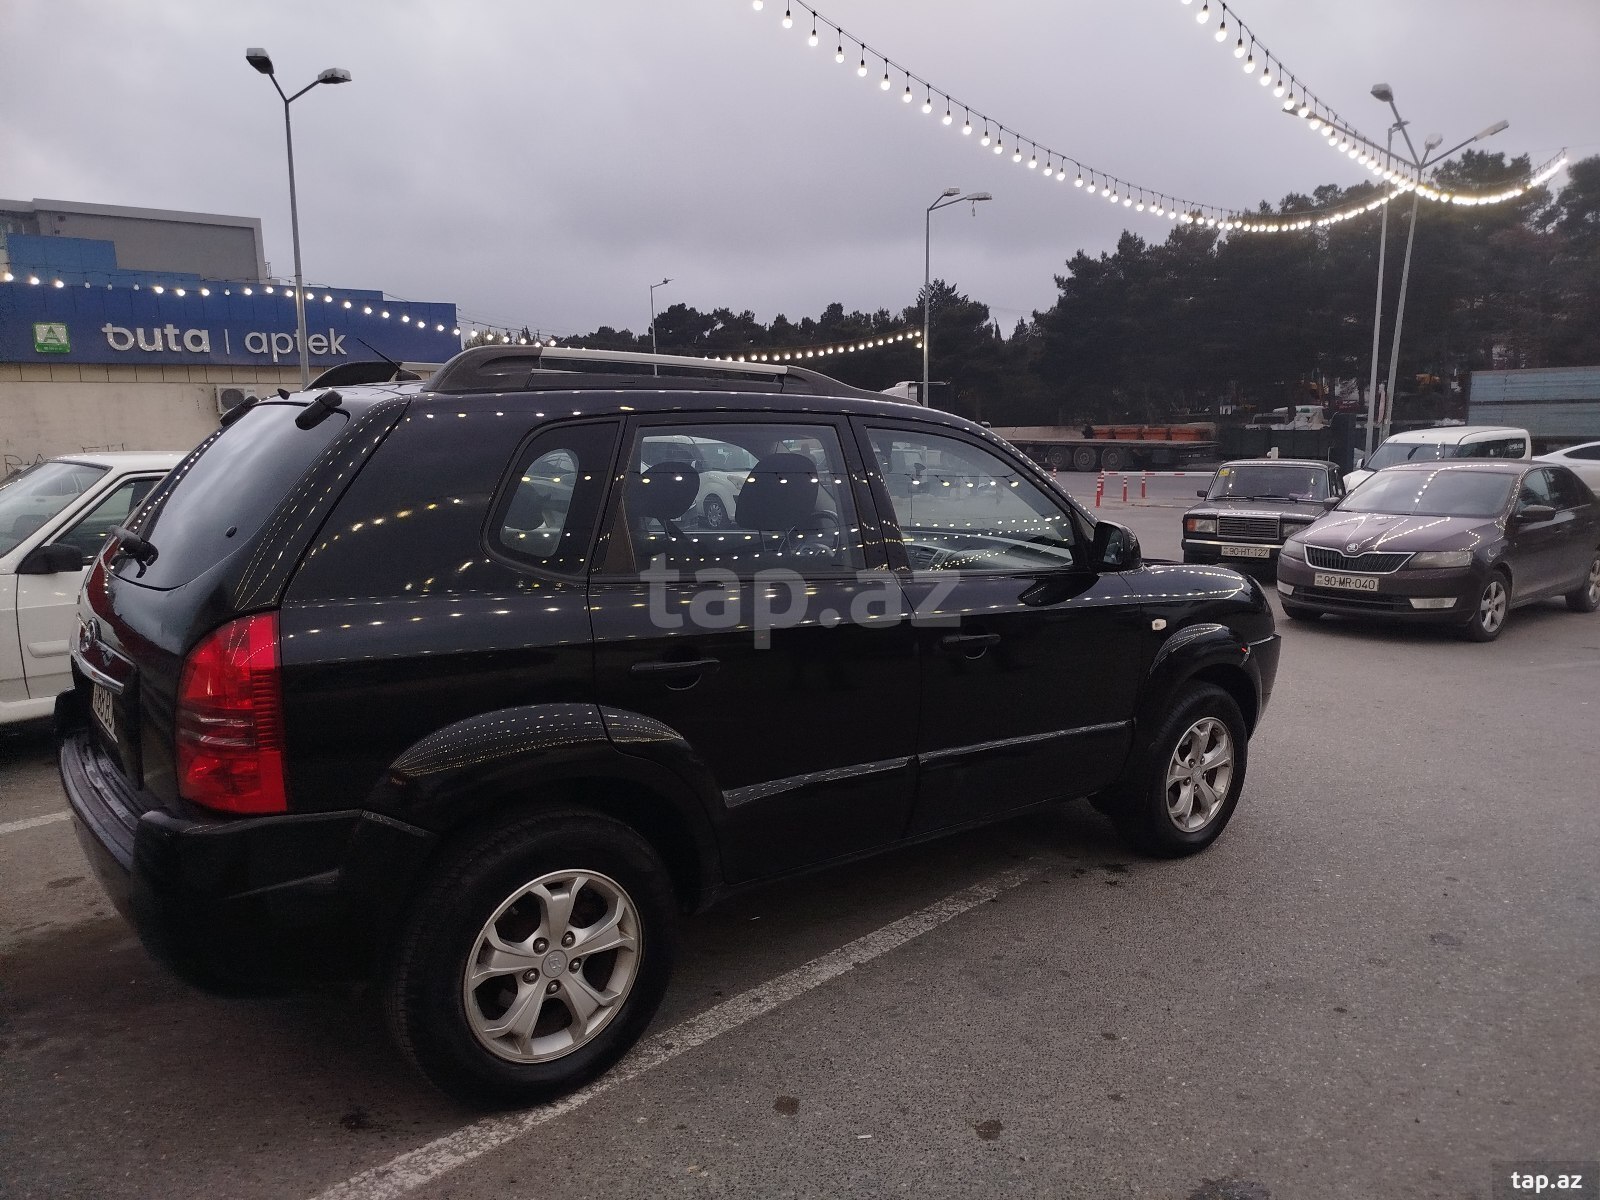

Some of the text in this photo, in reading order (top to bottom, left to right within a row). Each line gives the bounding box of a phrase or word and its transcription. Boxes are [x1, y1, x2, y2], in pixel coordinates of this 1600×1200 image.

[102, 323, 347, 362] buta aptek
[1324, 575, 1375, 589] 90-MR-040
